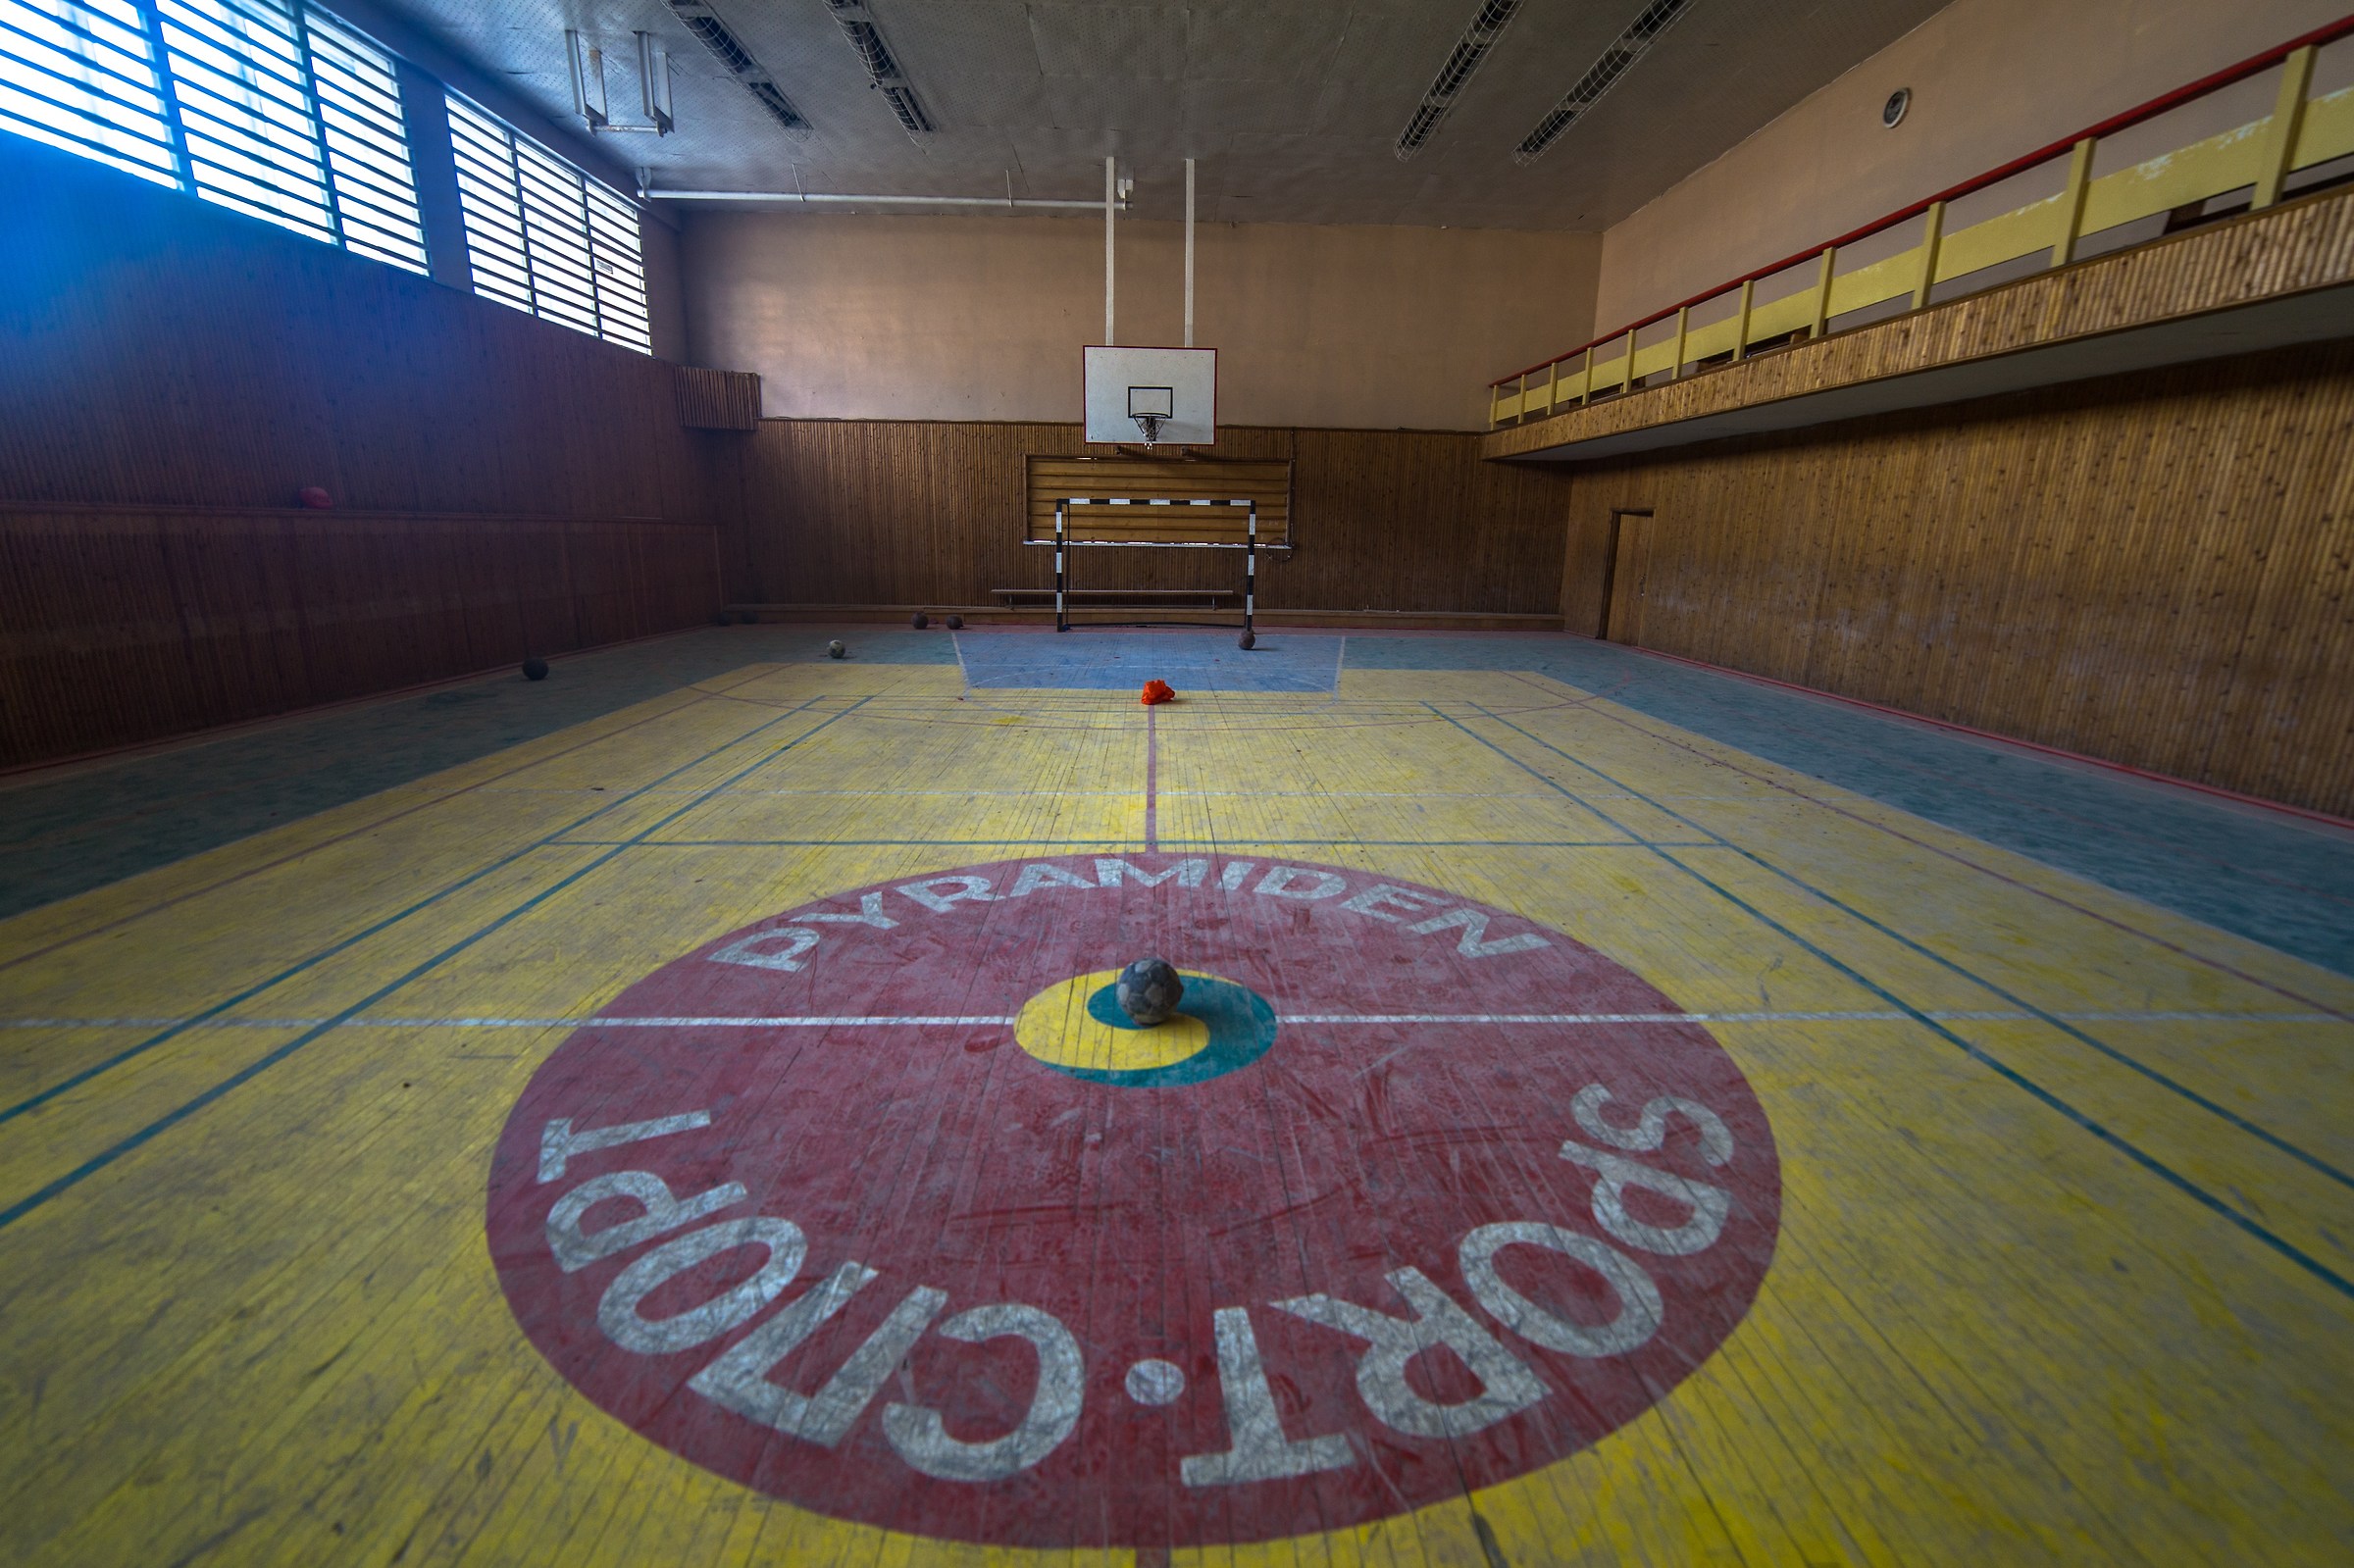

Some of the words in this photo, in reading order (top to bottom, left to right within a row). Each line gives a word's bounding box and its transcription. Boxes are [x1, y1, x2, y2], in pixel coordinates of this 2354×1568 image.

[706, 858, 1552, 972] PYRAMIDEN
[537, 1109, 1085, 1483] СПОРТ
[1180, 1083, 1734, 1488] SPORT
